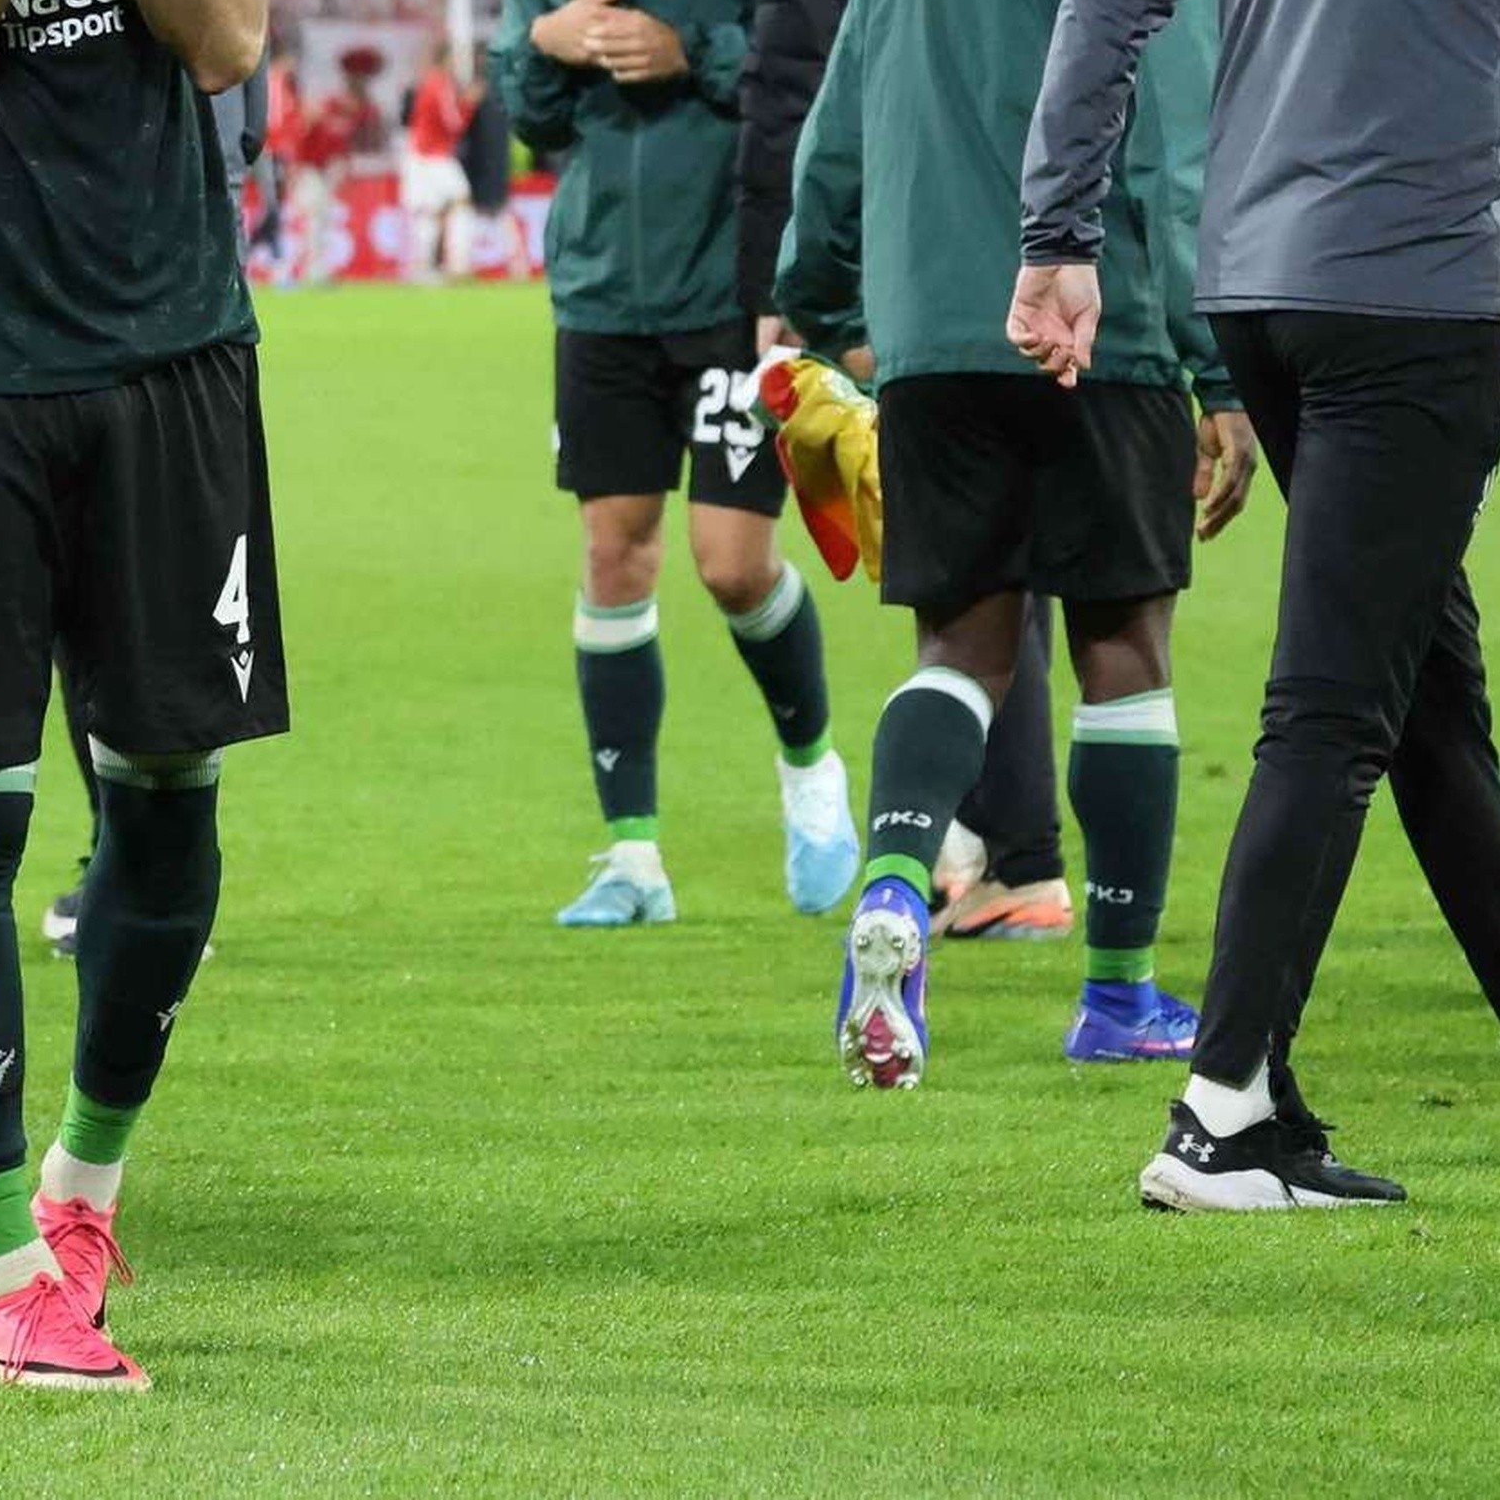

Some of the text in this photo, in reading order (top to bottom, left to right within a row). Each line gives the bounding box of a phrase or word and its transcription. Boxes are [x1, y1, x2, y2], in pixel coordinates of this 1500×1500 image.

[1, 5, 125, 53] Tipsport
[693, 367, 765, 448] 25
[212, 533, 250, 644] 4
